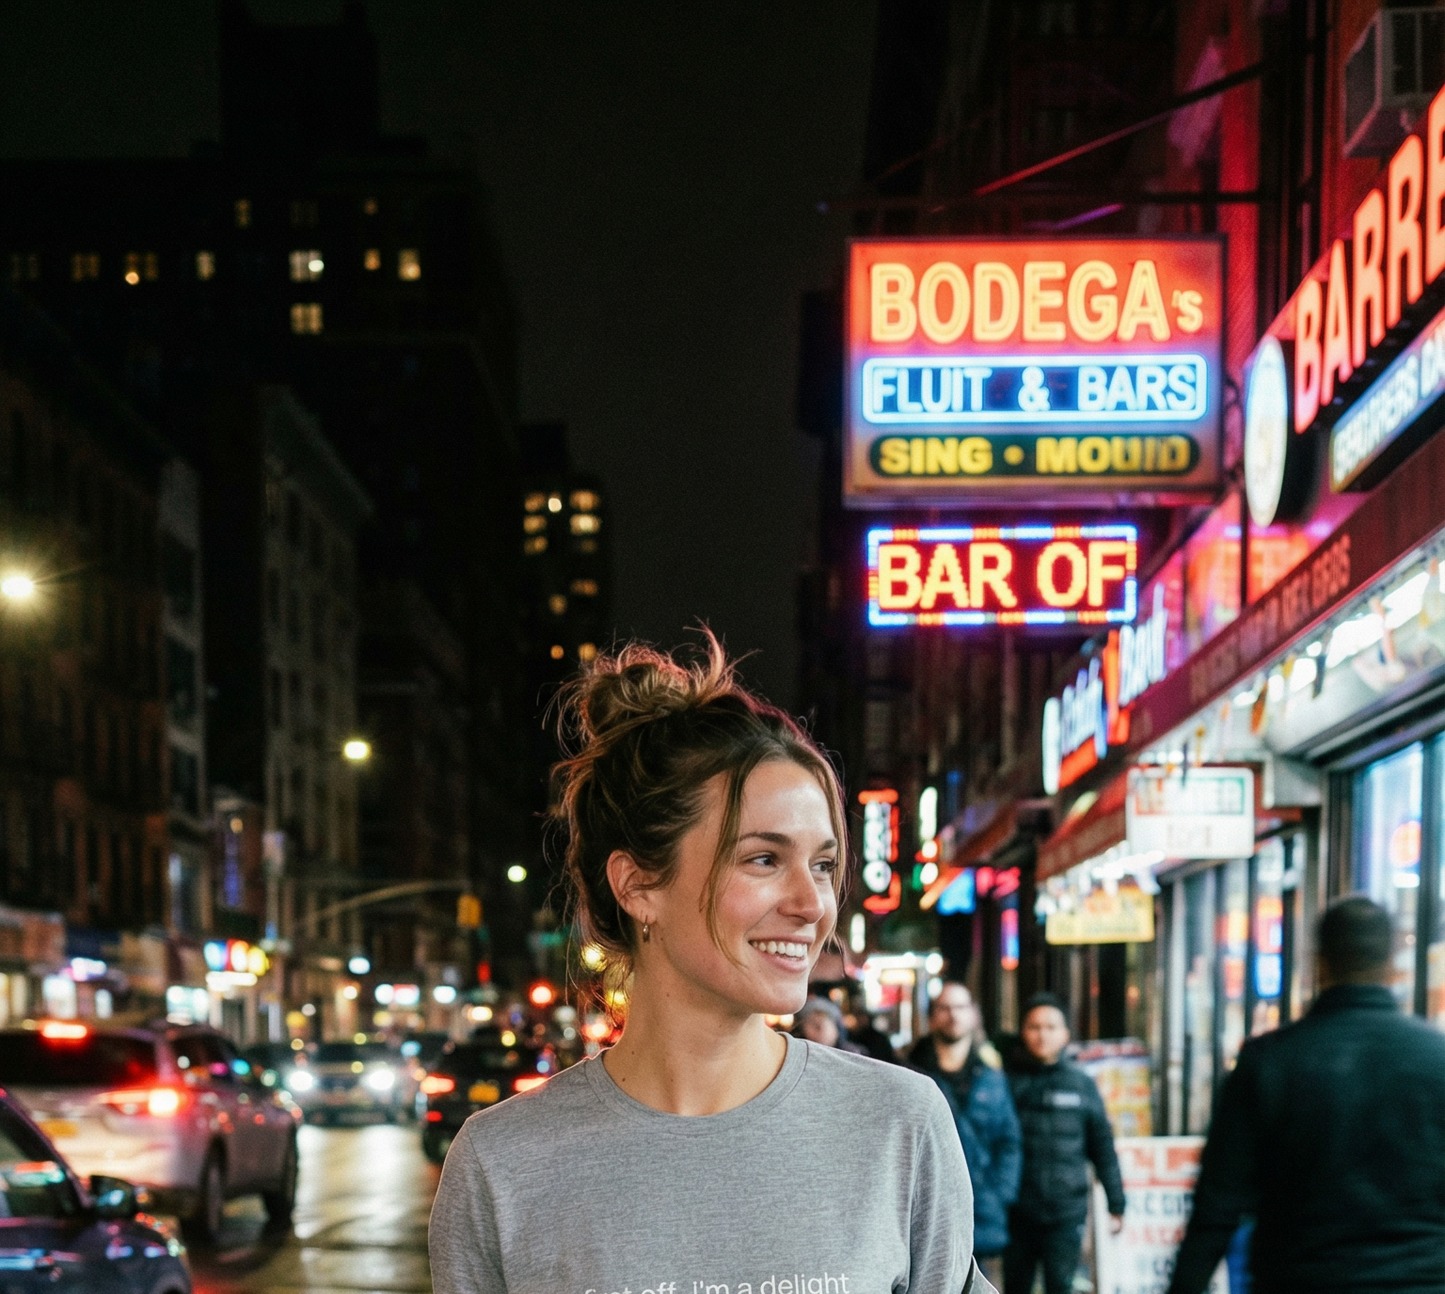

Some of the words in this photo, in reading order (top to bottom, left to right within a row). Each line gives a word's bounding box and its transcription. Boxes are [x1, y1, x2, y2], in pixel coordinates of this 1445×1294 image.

[872, 366, 993, 413] FLUIT
[1017, 365, 1051, 412] &
[1077, 364, 1198, 412] BARS
[878, 436, 994, 475] SING
[877, 541, 1018, 610] BAR
[1036, 540, 1130, 609] OF
